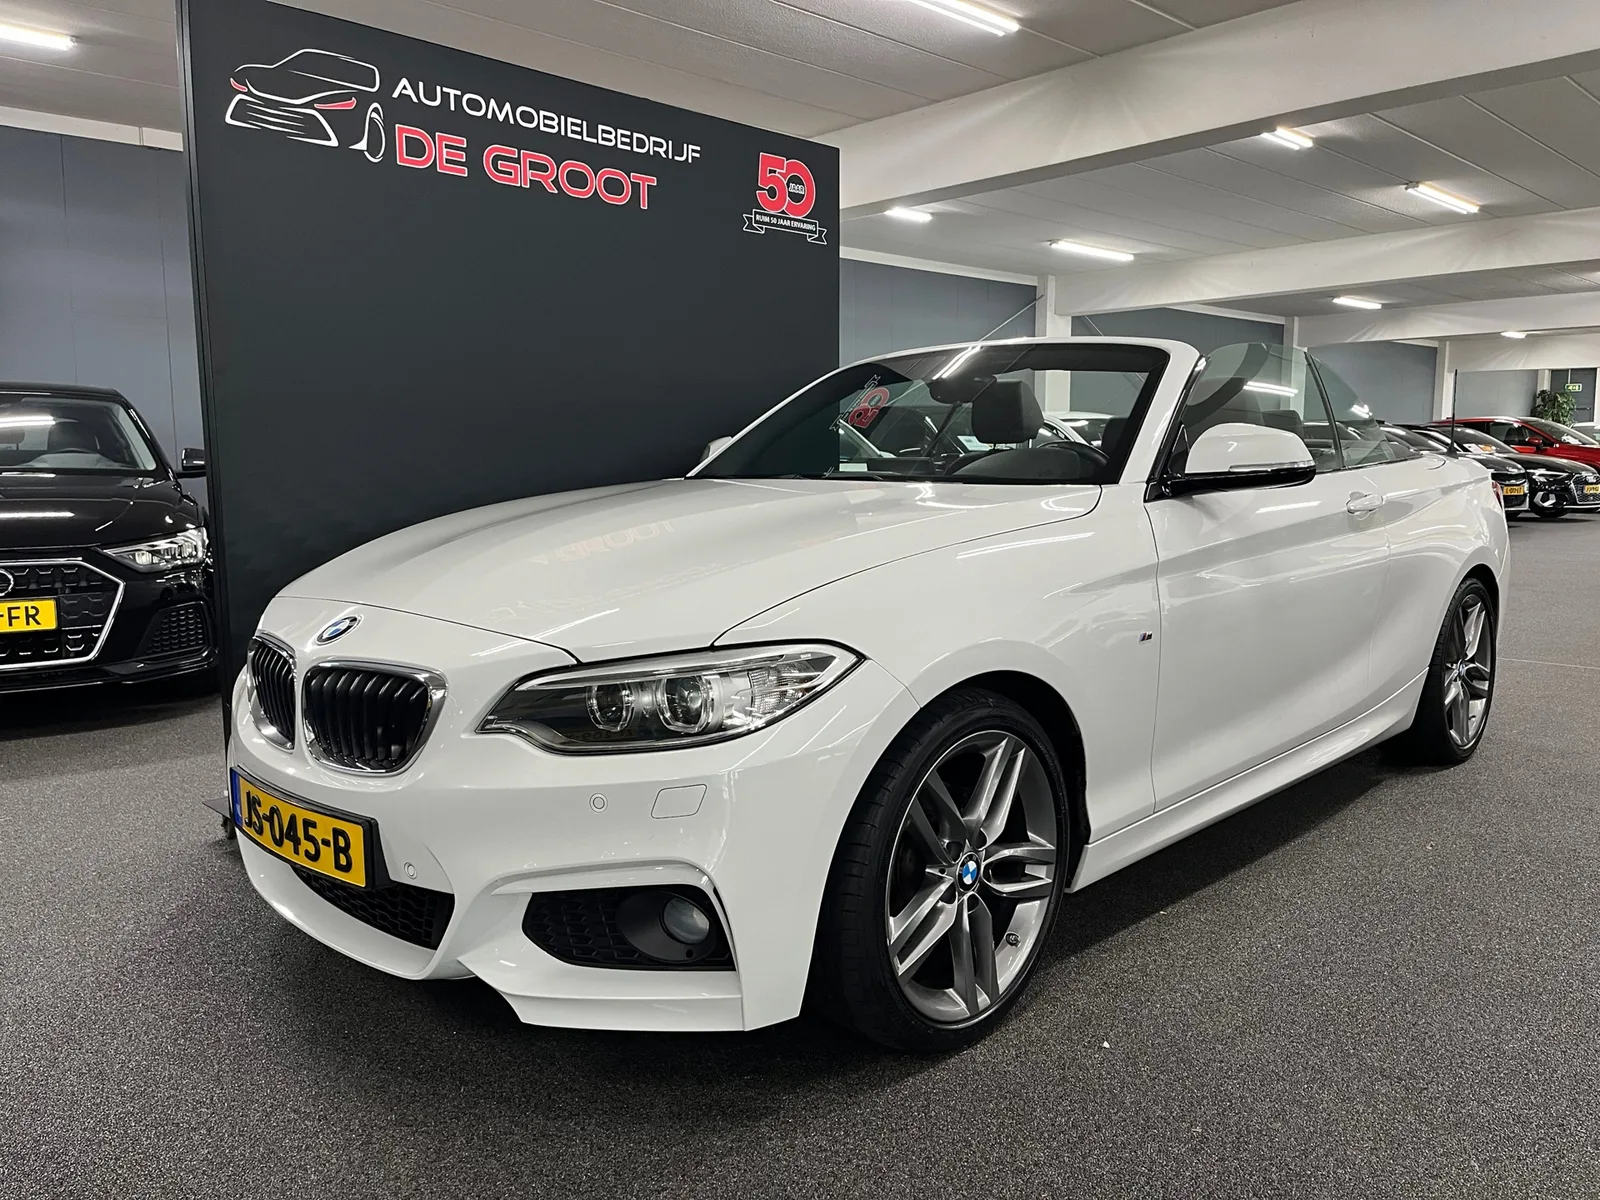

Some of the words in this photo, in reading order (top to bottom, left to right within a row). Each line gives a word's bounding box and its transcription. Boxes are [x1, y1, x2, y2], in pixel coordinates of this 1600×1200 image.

[392, 78, 701, 164] AUTOMOBIELBEDRIJF
[395, 124, 469, 178] DE
[483, 145, 658, 210] GROOT
[756, 152, 816, 218] 50
[756, 214, 770, 223] RUIM
[777, 218, 790, 226] JAAR
[791, 220, 816, 231] ERVARING
[244, 790, 353, 873] JS-045-B
